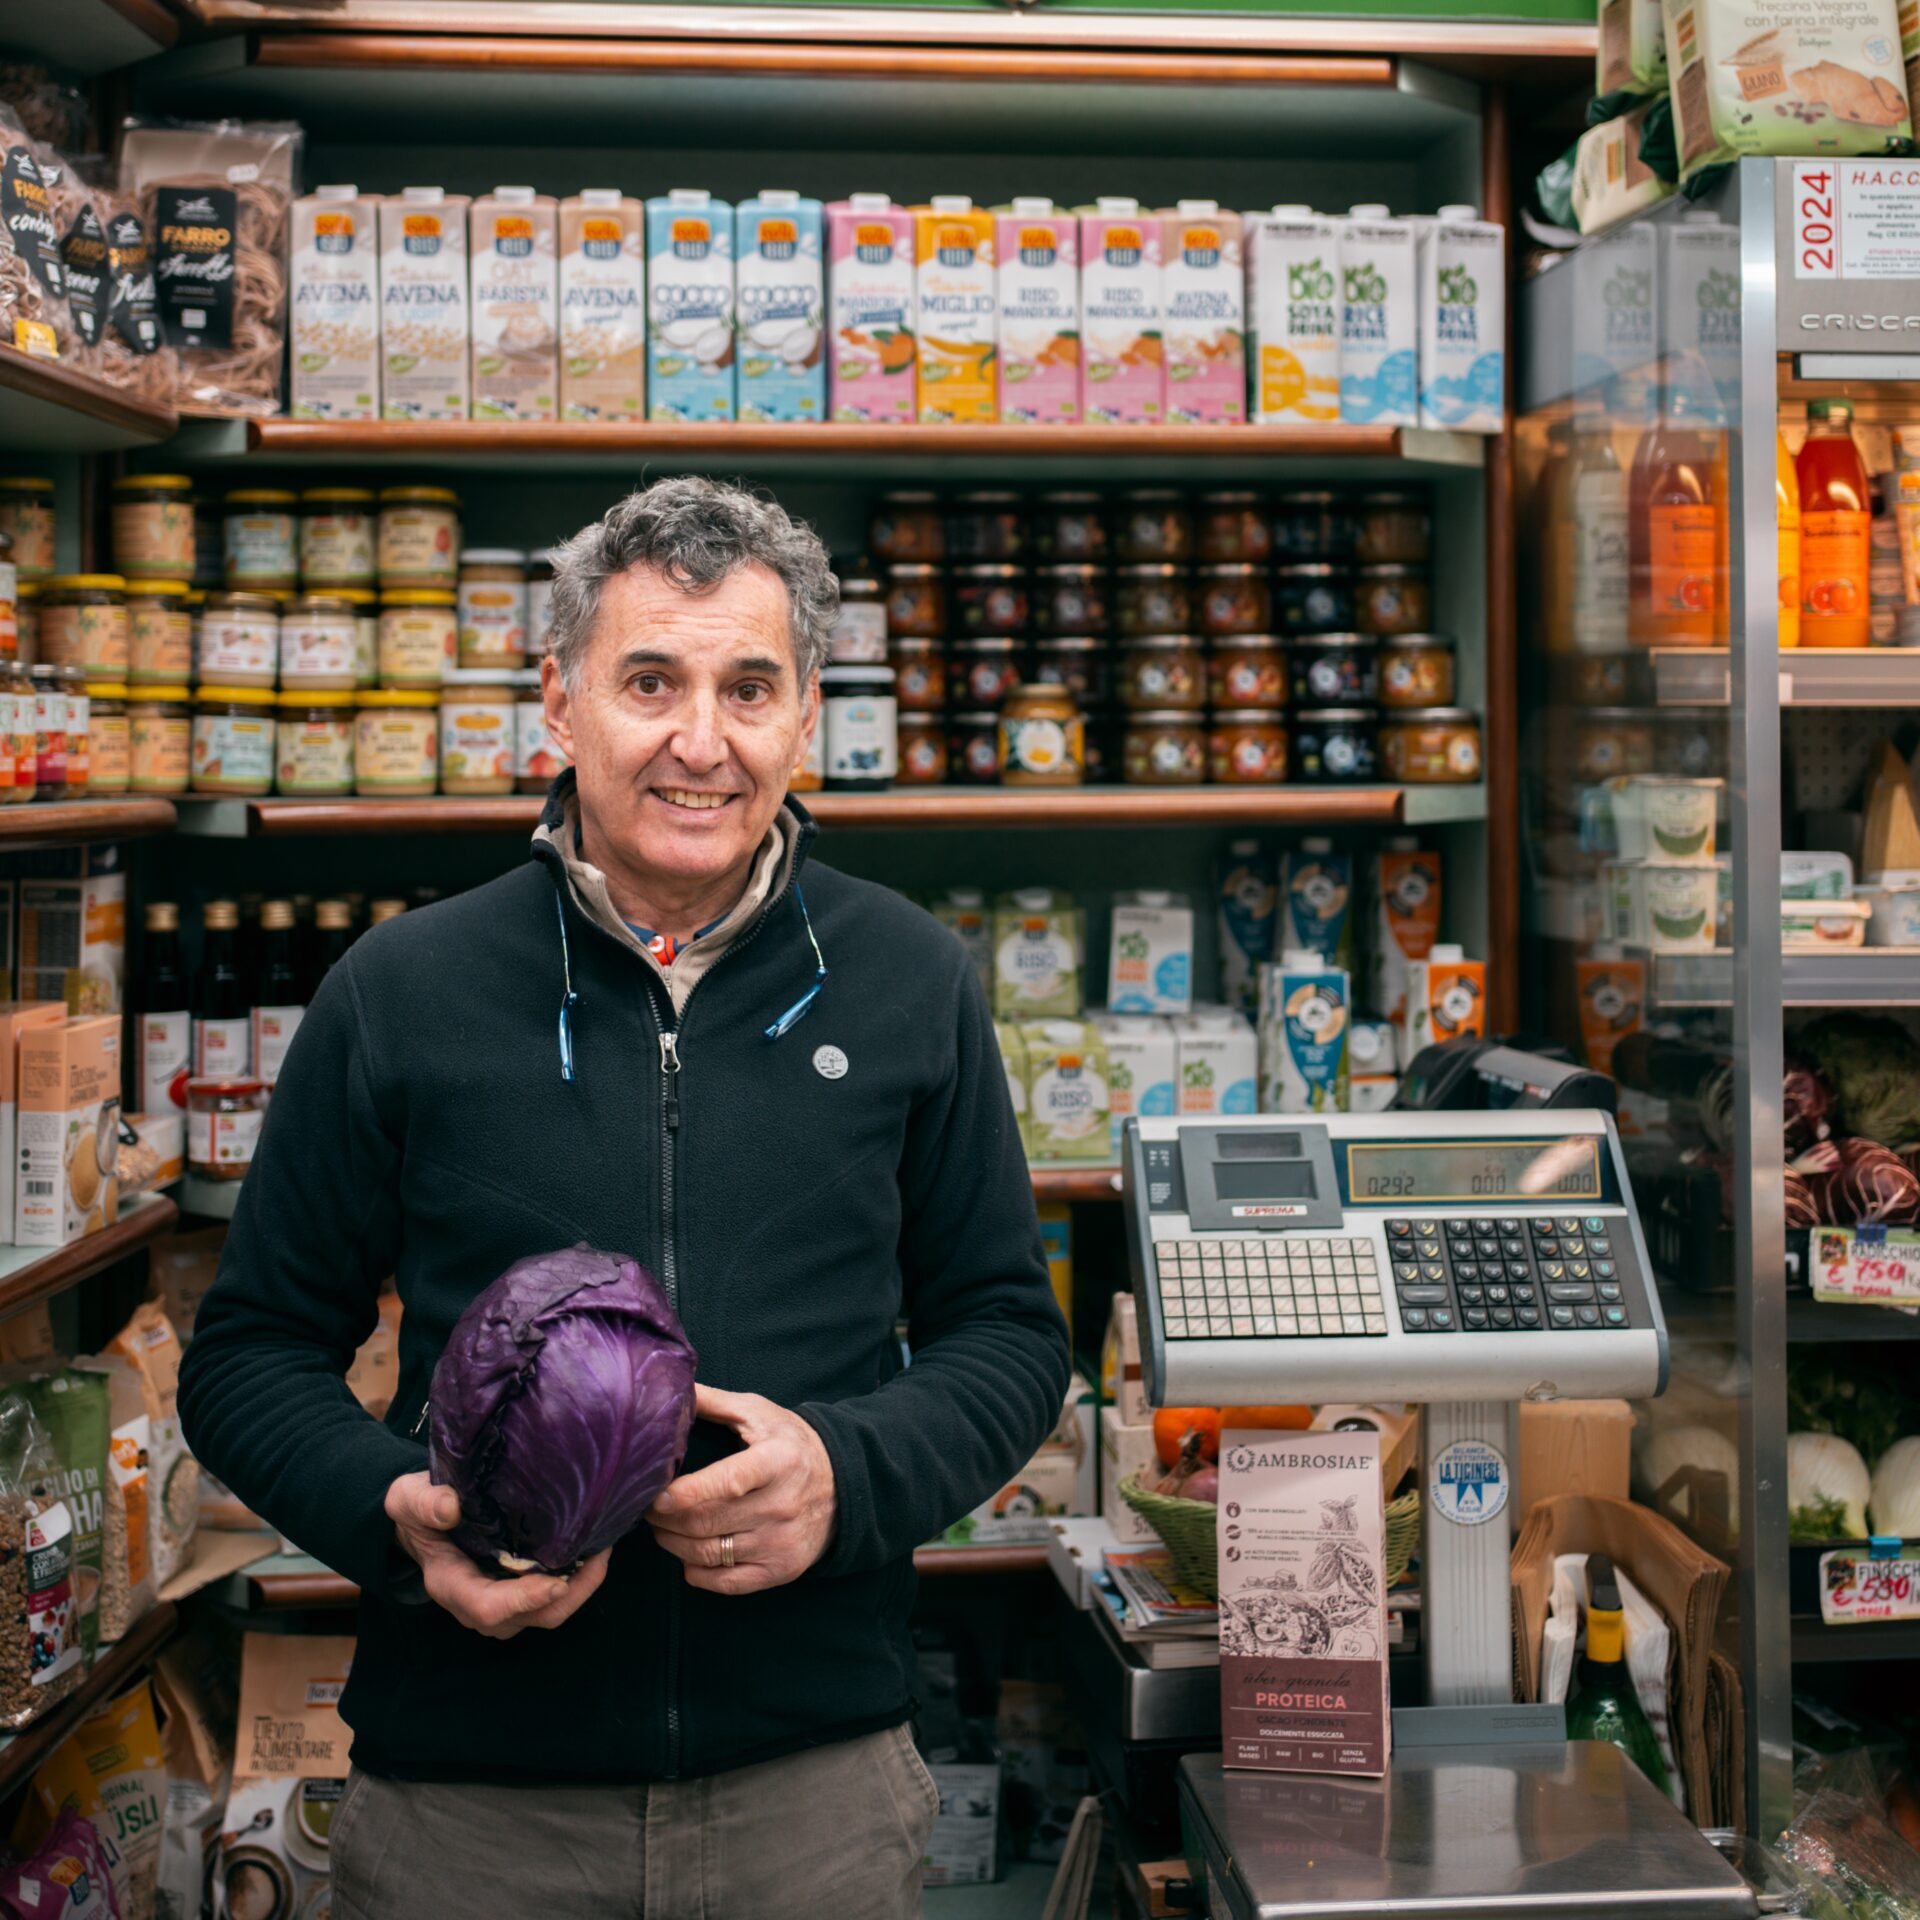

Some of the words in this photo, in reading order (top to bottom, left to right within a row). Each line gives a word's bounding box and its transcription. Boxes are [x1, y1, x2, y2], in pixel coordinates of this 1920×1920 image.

[1815, 0, 1867, 15] Vegana
[1744, 17, 1771, 27] con
[1774, 14, 1815, 27] farina
[1819, 14, 1879, 30] integrale
[1742, 71, 1781, 92] GRANO
[1802, 171, 1833, 270] 2024
[161, 226, 231, 247] FARRO
[295, 283, 371, 303] AVENA
[383, 285, 461, 303] AVENA
[564, 287, 638, 306] AVENA
[921, 295, 995, 314] MIGLIO
[1288, 304, 1334, 320] SOYA
[1344, 306, 1386, 323] RICE
[1438, 306, 1476, 325] RICE
[1801, 314, 1920, 331] CRIOCA
[1243, 1206, 1297, 1216] SUPREMA
[1489, 1288, 1506, 1298] 00
[1256, 1453, 1370, 1470] AMBROSIAE
[1439, 1463, 1452, 1479] LA
[1454, 1462, 1500, 1481] TICINESE
[1858, 1561, 1920, 1580] FINOCCH
[1255, 1692, 1347, 1709] PROTEICA
[1256, 1715, 1292, 1725] CACAO
[1295, 1717, 1347, 1727] FONDENTE
[253, 1721, 305, 1741] LIEVITO
[1259, 1728, 1306, 1738] DOLCEMENTE
[1306, 1730, 1345, 1739] ESSICCATA
[252, 1740, 335, 1760] ALIMENTARE
[1238, 1751, 1261, 1760] BASED
[1338, 1756, 1368, 1764] GLUTINE
[1341, 1749, 1364, 1757] SENZA
